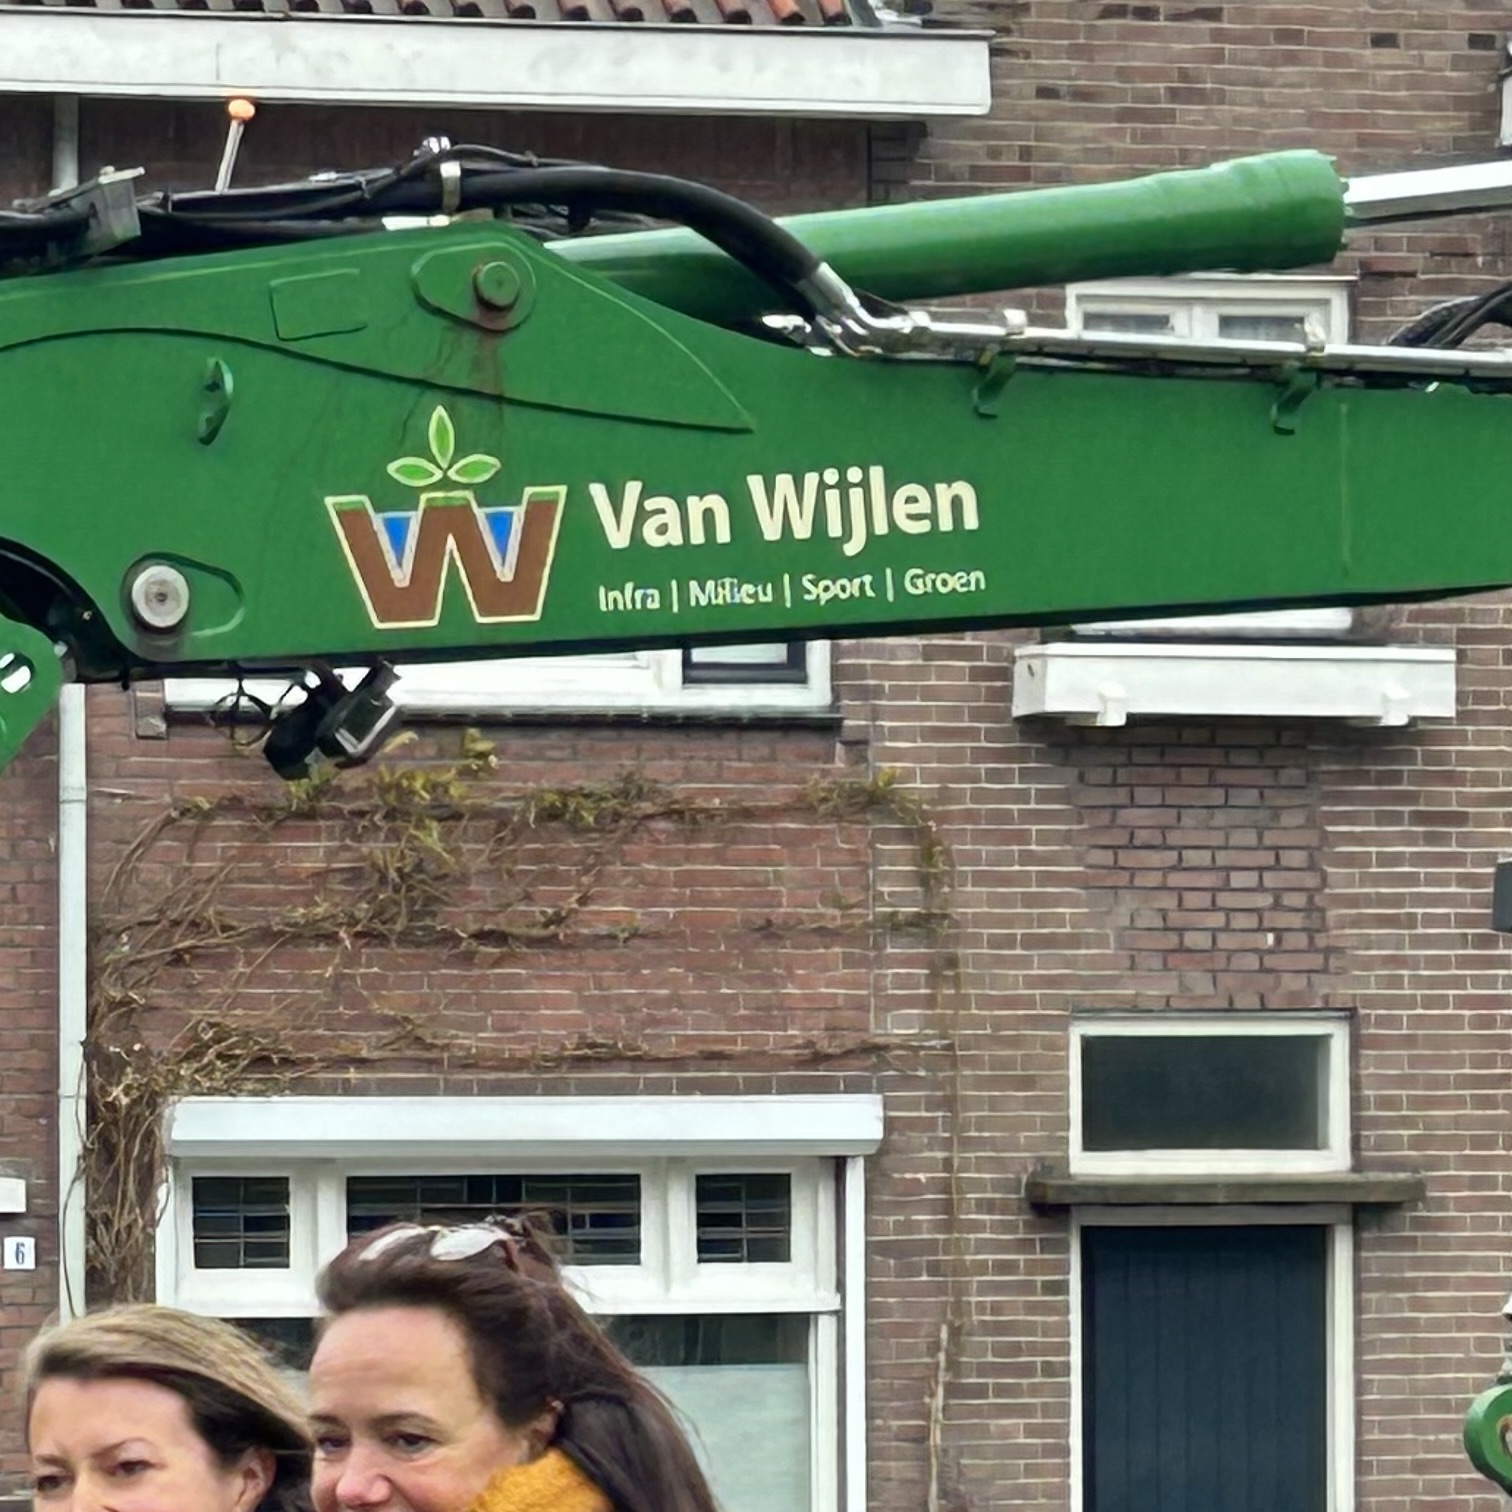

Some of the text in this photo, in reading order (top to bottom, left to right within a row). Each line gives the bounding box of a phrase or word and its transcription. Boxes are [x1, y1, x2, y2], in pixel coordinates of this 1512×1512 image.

[589, 466, 979, 556] Van Wijlen
[599, 582, 660, 611] Infra
[802, 574, 875, 605] Sport
[904, 569, 985, 594] Groen
[15, 1241, 26, 1266] 6
